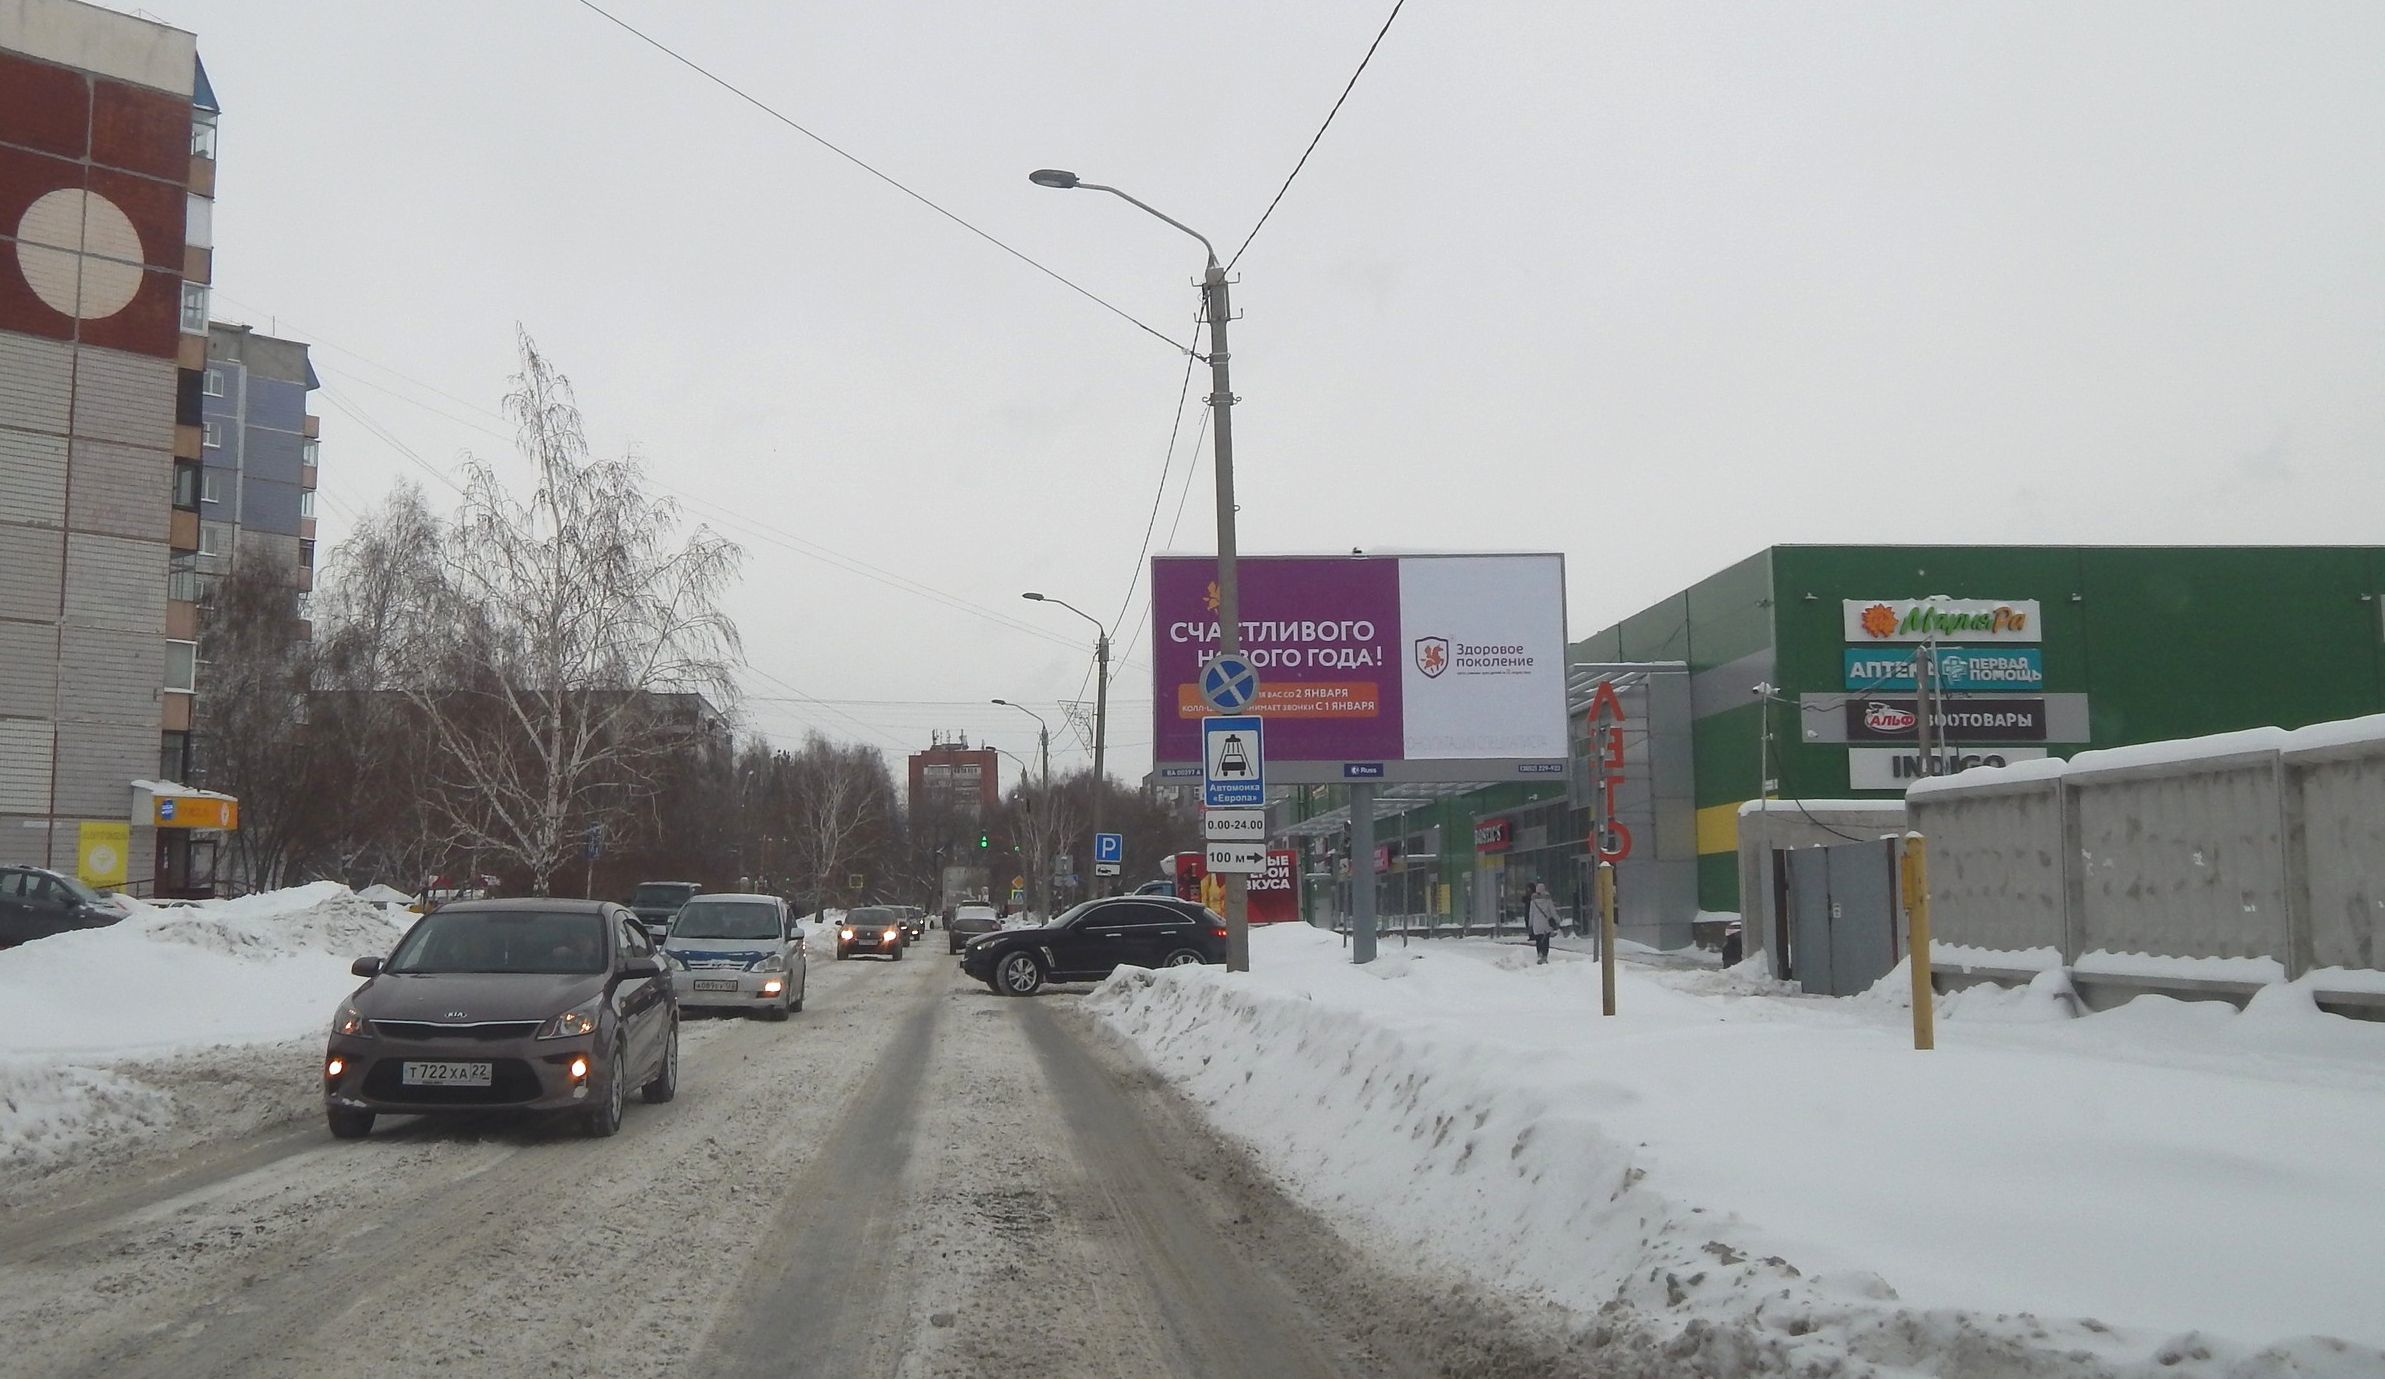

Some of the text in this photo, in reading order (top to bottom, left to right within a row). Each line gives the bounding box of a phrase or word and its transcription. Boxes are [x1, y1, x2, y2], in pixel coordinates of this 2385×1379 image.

[1170, 621, 1375, 643] СЧАТЛИВОГО
[1456, 643, 1524, 655] Здоровое
[1307, 646, 1383, 669] ГОДА!
[1456, 656, 1534, 667] поколение
[1969, 657, 2028, 670] ПЕРВАЯ
[1969, 669, 2042, 682] ПОМОЩЬ
[1296, 689, 1303, 698] 2
[1304, 689, 1348, 698] ЯНВАРЯ
[1331, 702, 1375, 711] ЯНВАРЯ
[1207, 820, 1264, 830] 0.00-24.00
[1209, 852, 1231, 863] 100
